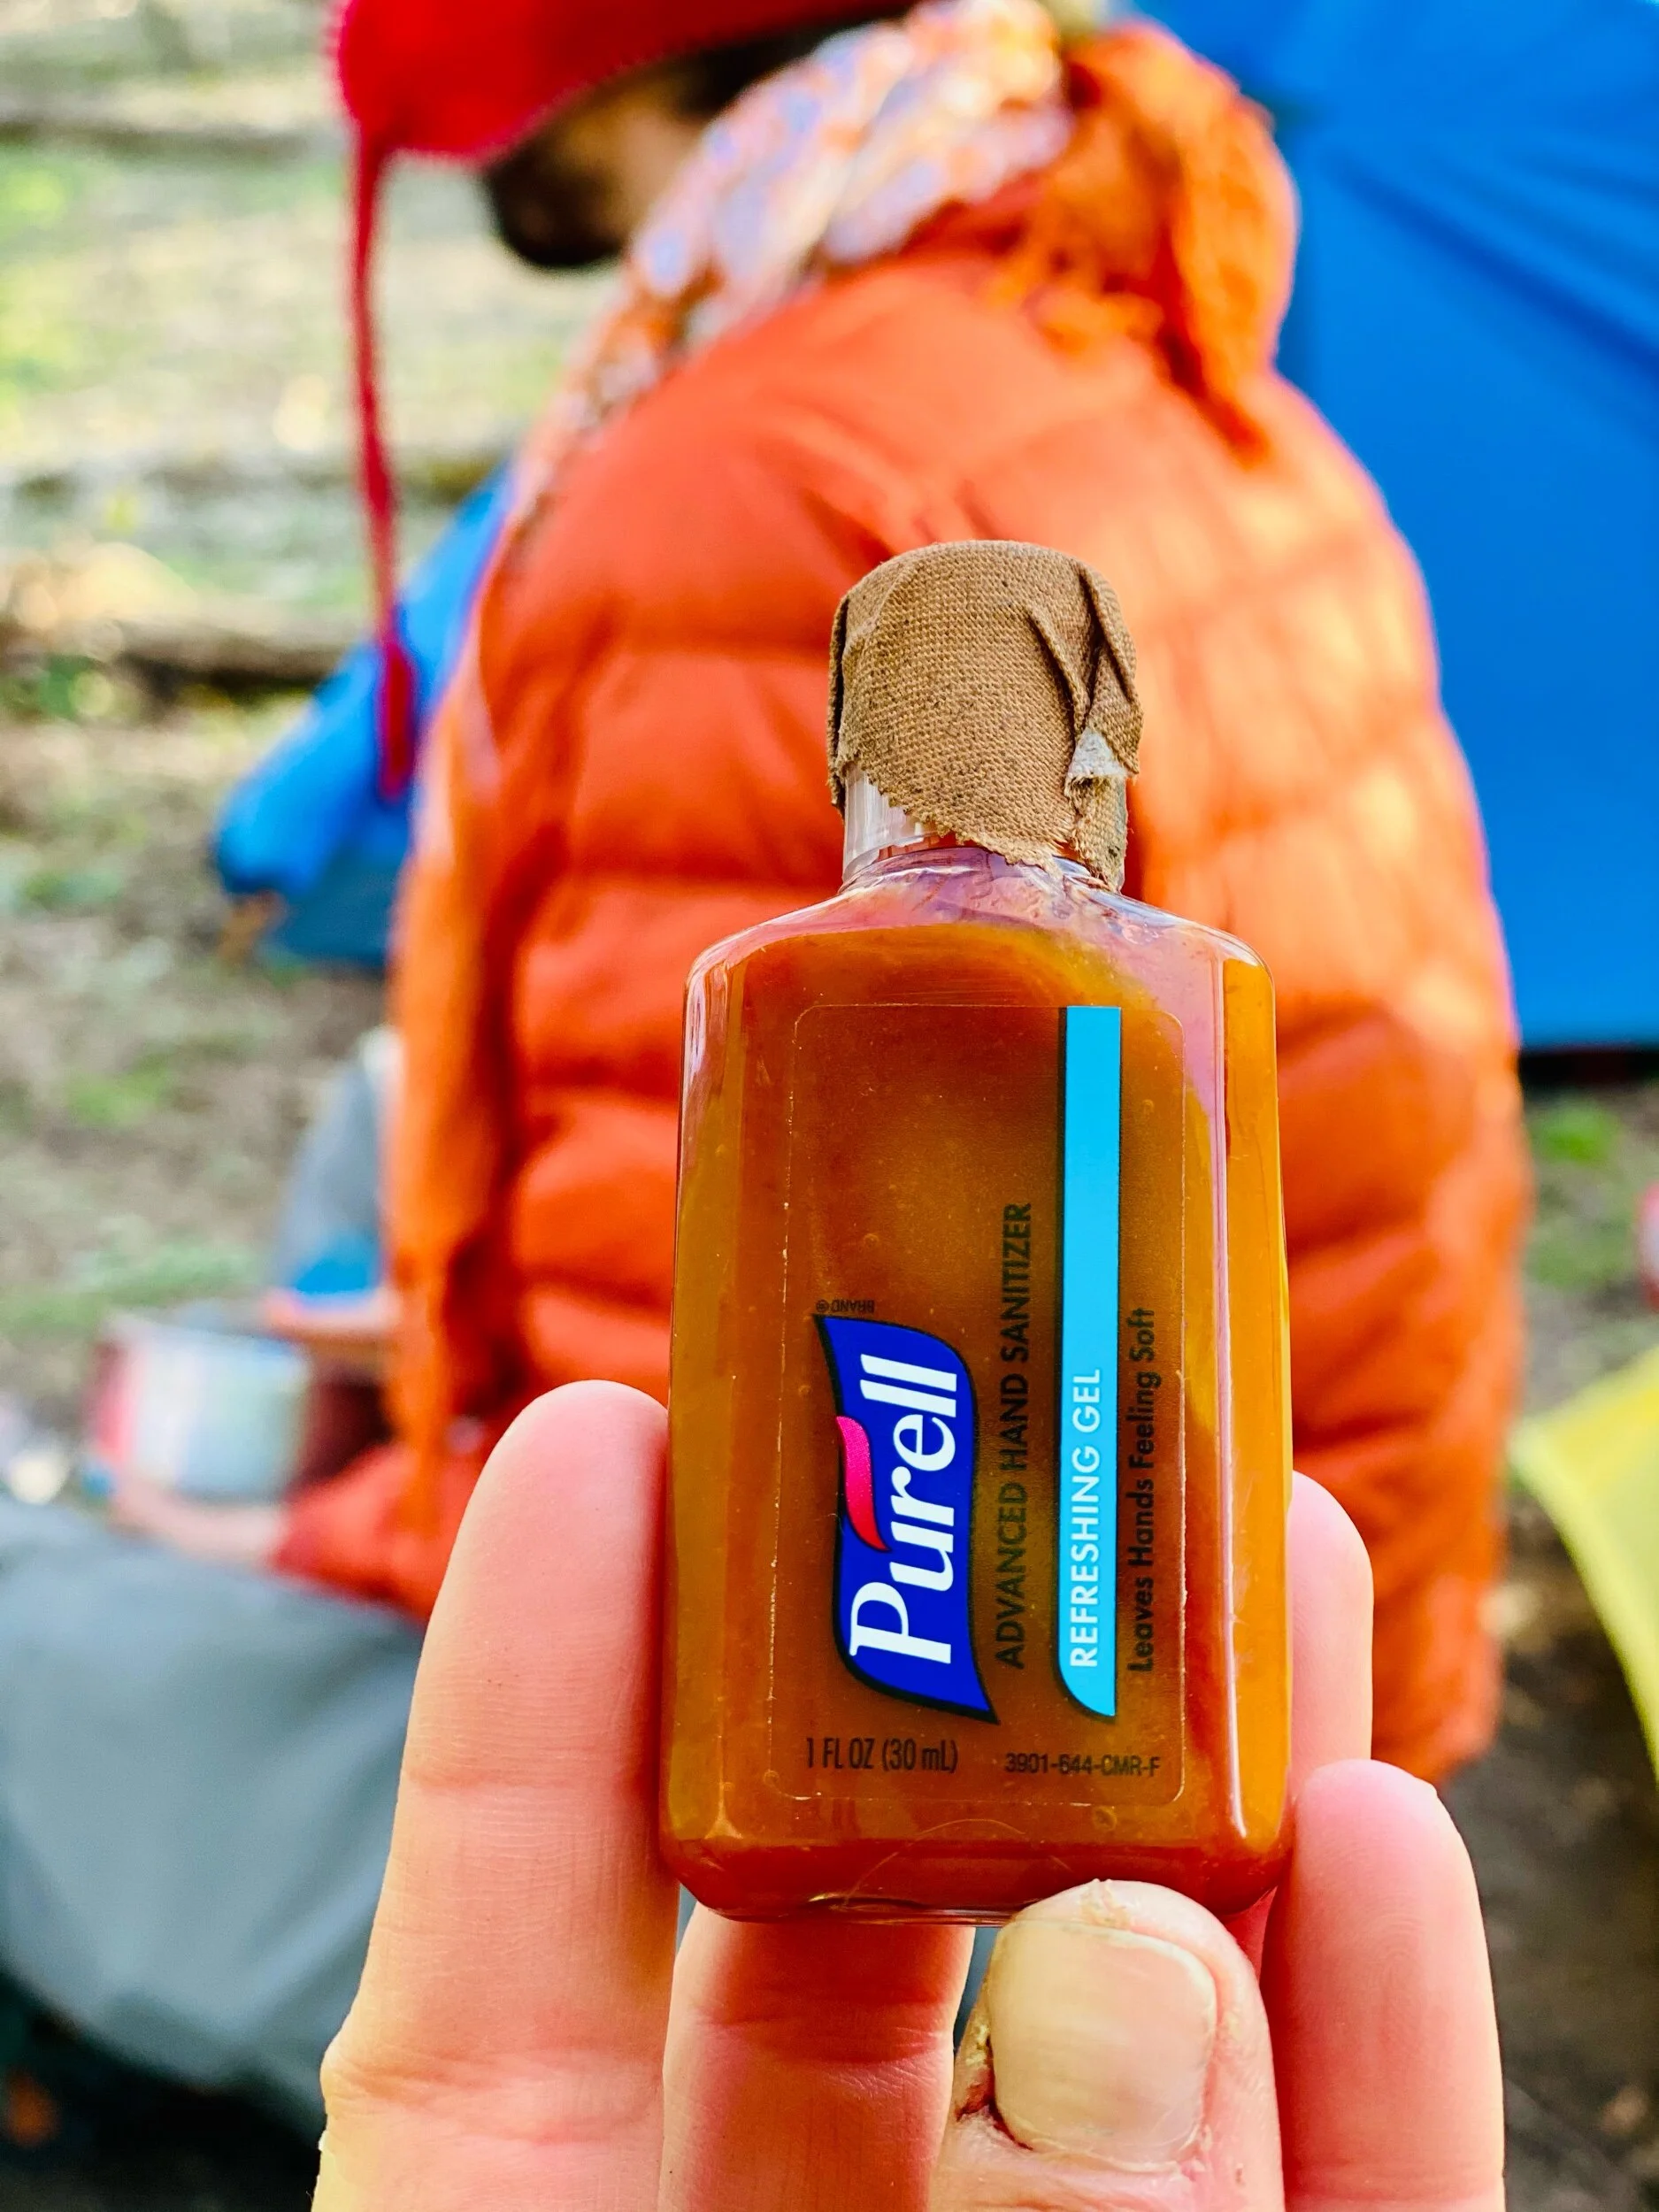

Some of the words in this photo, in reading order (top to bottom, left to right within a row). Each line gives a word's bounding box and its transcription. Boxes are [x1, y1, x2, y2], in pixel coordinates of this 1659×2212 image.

[1000, 1202, 1032, 1364] SANITIZER
[1125, 1307, 1156, 1363] Soft
[998, 1372, 1029, 1471] HAND
[1071, 1369, 1101, 1433] GEL
[1125, 1371, 1162, 1470] Feeling
[849, 1353, 957, 1664] Purell
[1069, 1445, 1101, 1668] REFRESHING
[1125, 1478, 1155, 1567] Hands
[994, 1480, 1029, 1671] ADVANCED
[1127, 1575, 1155, 1673] Leaves
[806, 1737, 815, 1769] 1
[822, 1737, 844, 1770] FL
[849, 1737, 876, 1770] OZ
[881, 1737, 918, 1772] (30
[921, 1739, 959, 1774] mL)
[1004, 1752, 1162, 1778] 3901-644-CMR-F
